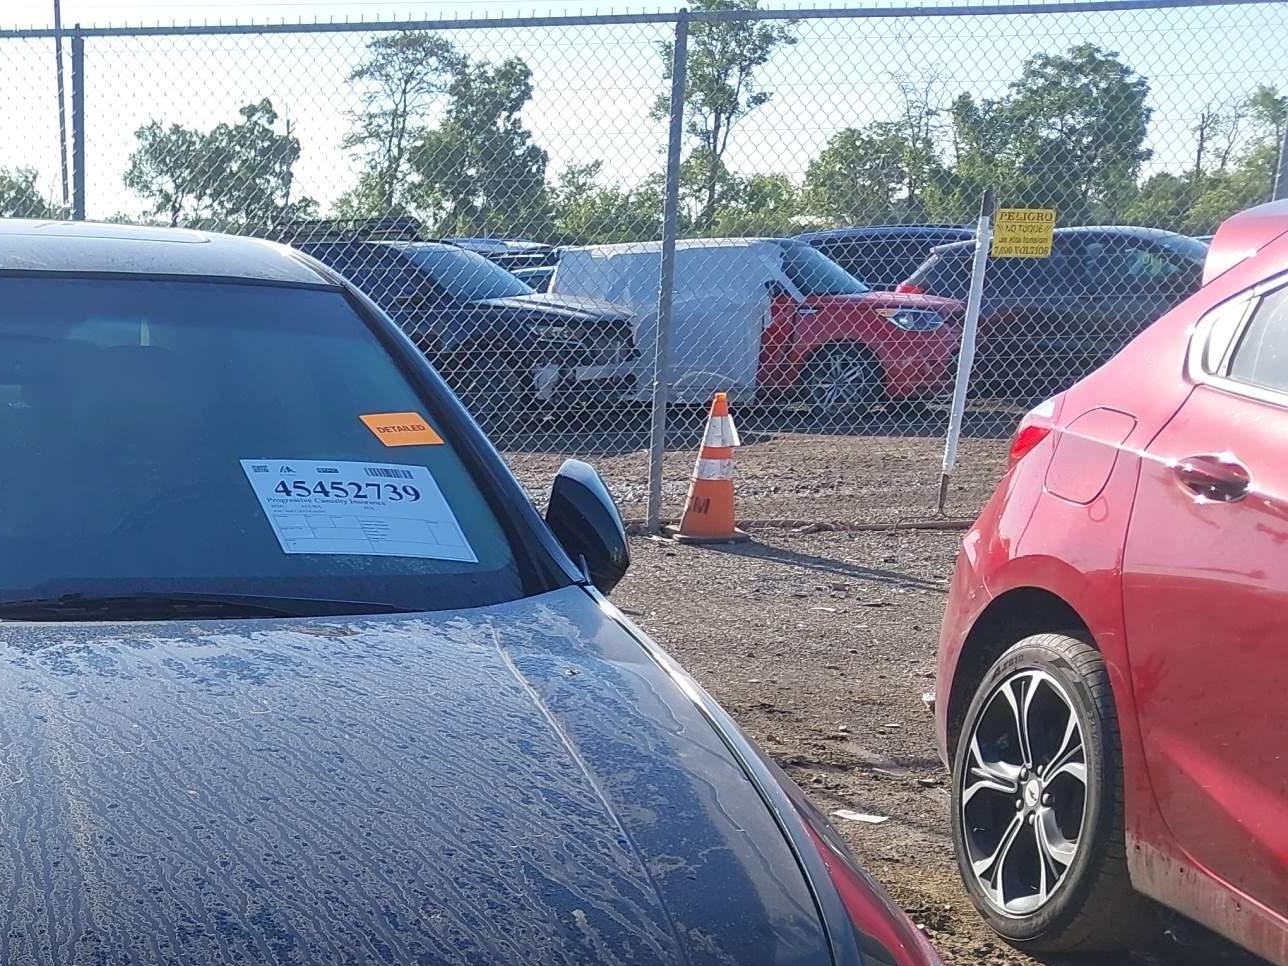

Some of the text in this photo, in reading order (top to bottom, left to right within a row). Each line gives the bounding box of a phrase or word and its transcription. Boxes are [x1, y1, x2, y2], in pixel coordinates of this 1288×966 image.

[1000, 212, 1053, 221] PELIGRO
[1006, 225, 1043, 233] NO TOQUE
[376, 425, 425, 433] DETAILED
[274, 480, 421, 502] 45452739
